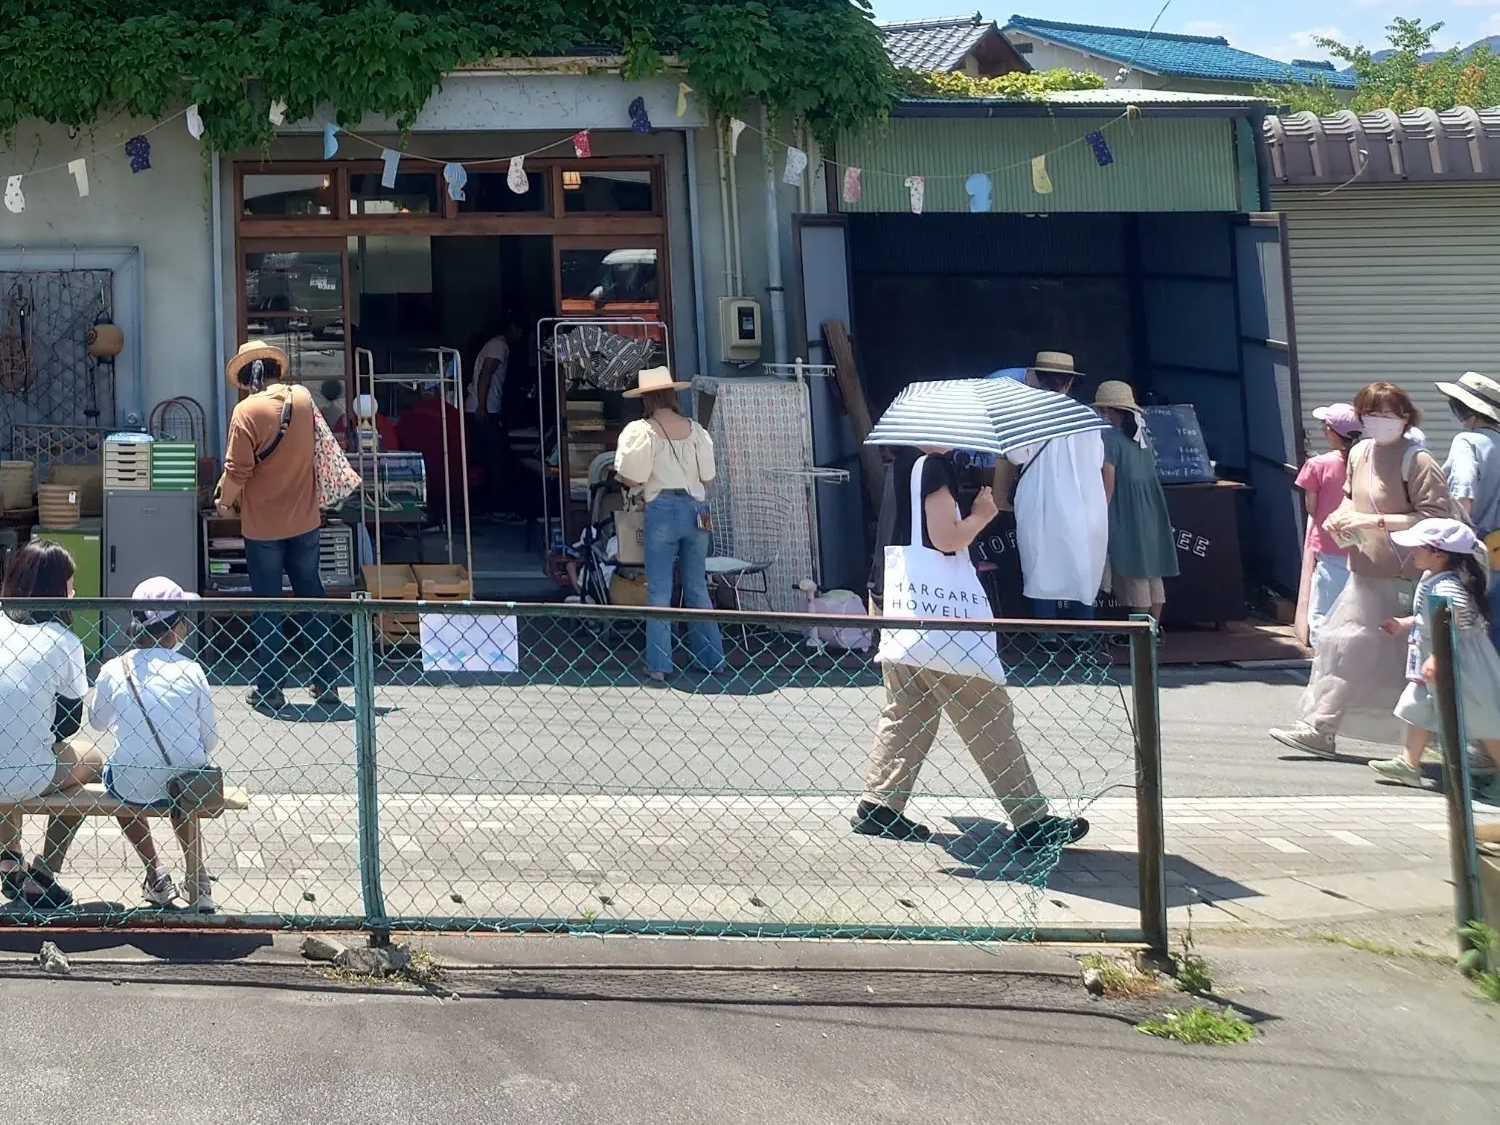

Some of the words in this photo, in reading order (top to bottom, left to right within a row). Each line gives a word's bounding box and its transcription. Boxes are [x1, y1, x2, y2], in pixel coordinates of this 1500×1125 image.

[68, 158, 90, 197] 1
[381, 148, 401, 189] 1
[904, 175, 927, 214] 1
[965, 172, 992, 213] 2
[1085, 129, 1114, 166] 1
[892, 599, 971, 618] HOWELL
[894, 582, 989, 607] MARGARET
